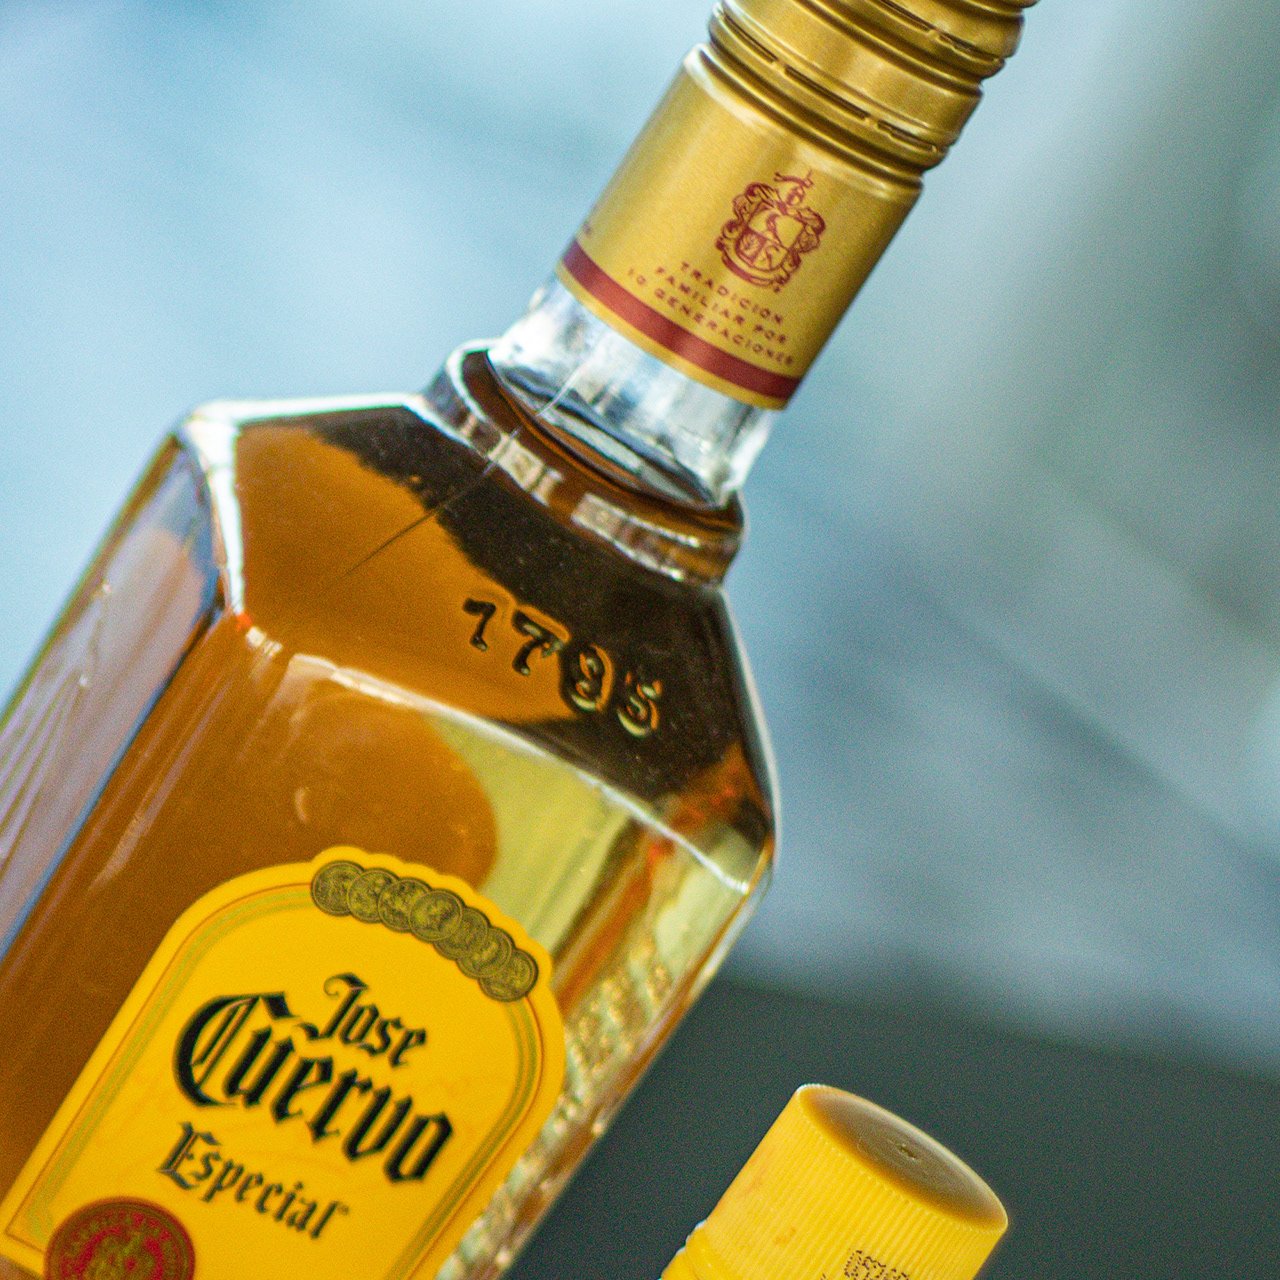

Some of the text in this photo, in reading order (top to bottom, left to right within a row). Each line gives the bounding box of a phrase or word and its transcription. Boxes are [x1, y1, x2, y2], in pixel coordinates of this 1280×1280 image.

[656, 266, 787, 345] FAMILIAR POR
[681, 261, 784, 325] TRADICION
[296, 972, 427, 1069] Jose
[172, 991, 454, 1184] Cuervo
